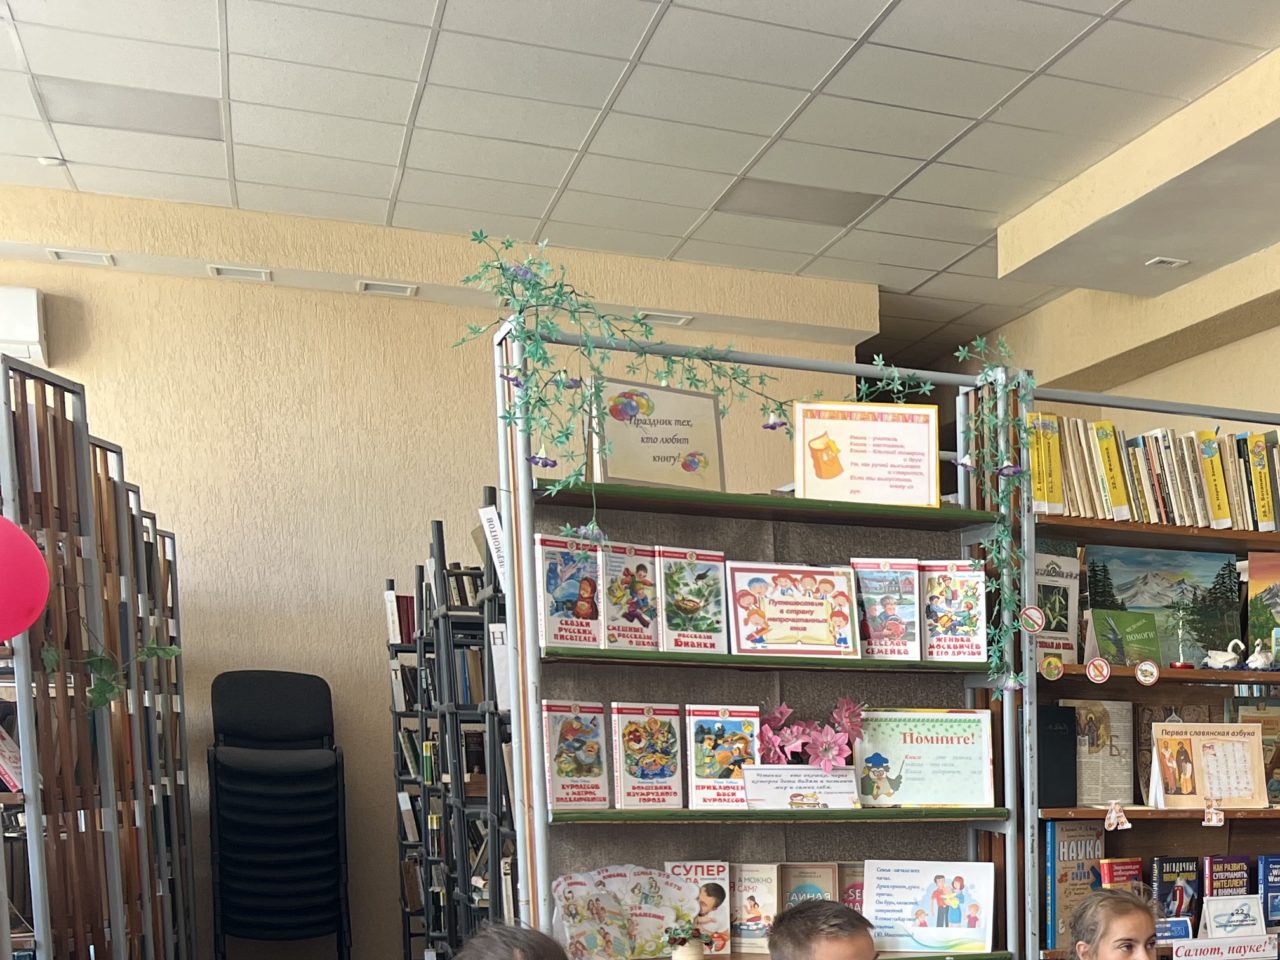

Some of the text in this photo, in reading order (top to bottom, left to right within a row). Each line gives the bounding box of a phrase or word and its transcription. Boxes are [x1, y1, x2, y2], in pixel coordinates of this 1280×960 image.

[629, 414, 693, 428] Праздник тех,
[641, 434, 689, 445] кто любит
[653, 452, 681, 465] книгу!
[768, 599, 824, 607] Путешествие
[559, 619, 591, 627] СКАЗКИ
[558, 627, 592, 635] РУССКИХ
[607, 625, 644, 633] СМЕШНЫЕ
[553, 634, 597, 643] ПИСАТЕЛЕЙ
[617, 632, 652, 640] РАССКАЗЫ
[902, 732, 976, 745] Помните!
[1161, 729, 1256, 738] Первая славянская азбука
[1060, 840, 1101, 861] НАУКА
[671, 865, 726, 876] СУПЕР
[1163, 862, 1197, 873] ЗАГАДОЧНЫЕ
[1212, 862, 1248, 872] КАК РАЗВИТЬ
[1213, 879, 1248, 888] ИНТЕЛЛЕКТ
[786, 891, 831, 901] ТАЙНАЯ
[1219, 888, 1248, 896] ВНИМАНИЕ
[1175, 940, 1268, 959] Салют, науке!
